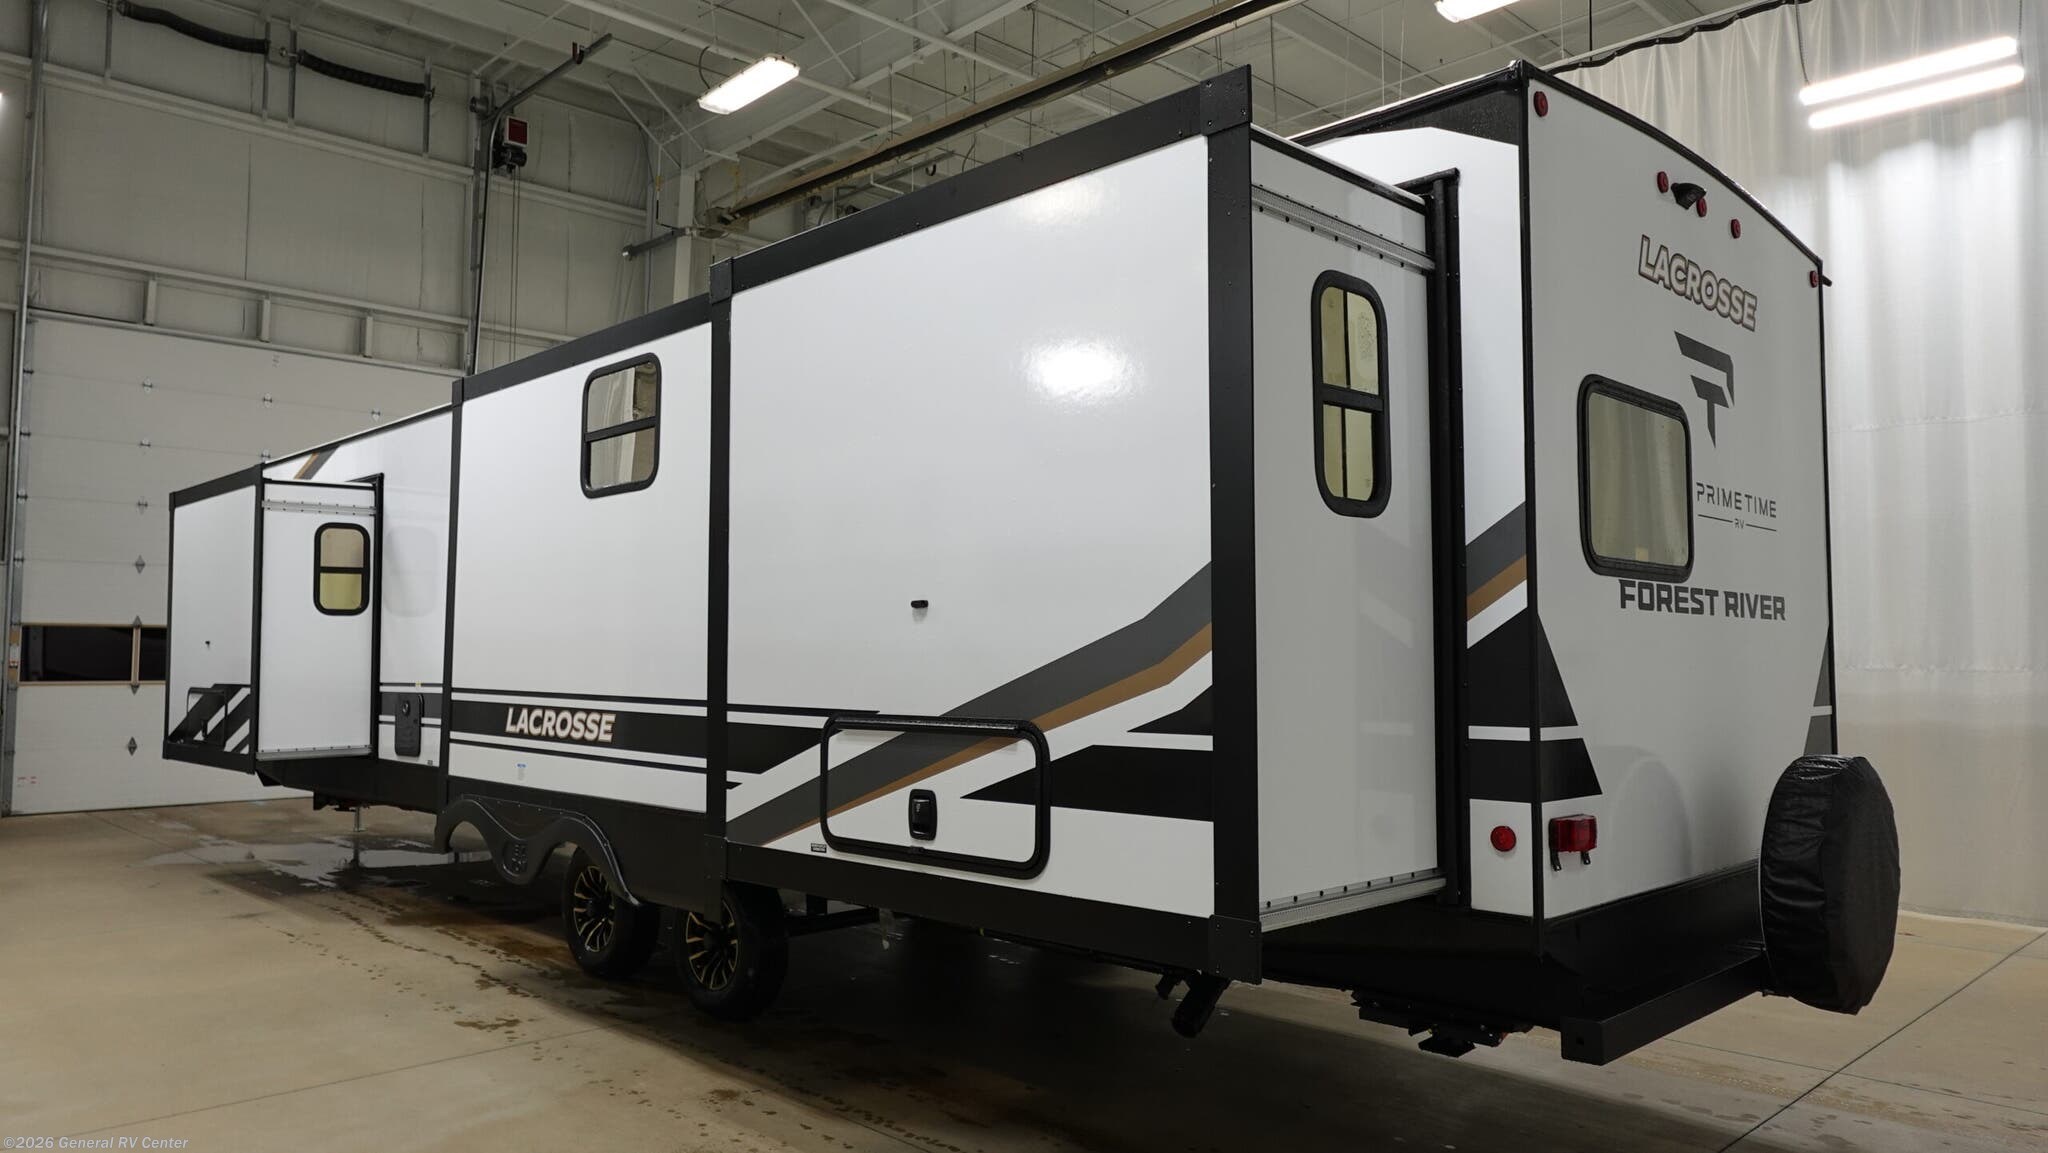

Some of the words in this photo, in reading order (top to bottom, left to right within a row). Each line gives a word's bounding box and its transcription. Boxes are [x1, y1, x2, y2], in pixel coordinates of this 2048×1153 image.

[1638, 234, 1757, 332] LACROSSE
[1734, 518, 1745, 529] RV
[1618, 579, 1719, 616] FOREST
[1723, 591, 1786, 621] RIVER
[505, 706, 616, 743] LACROSSE
